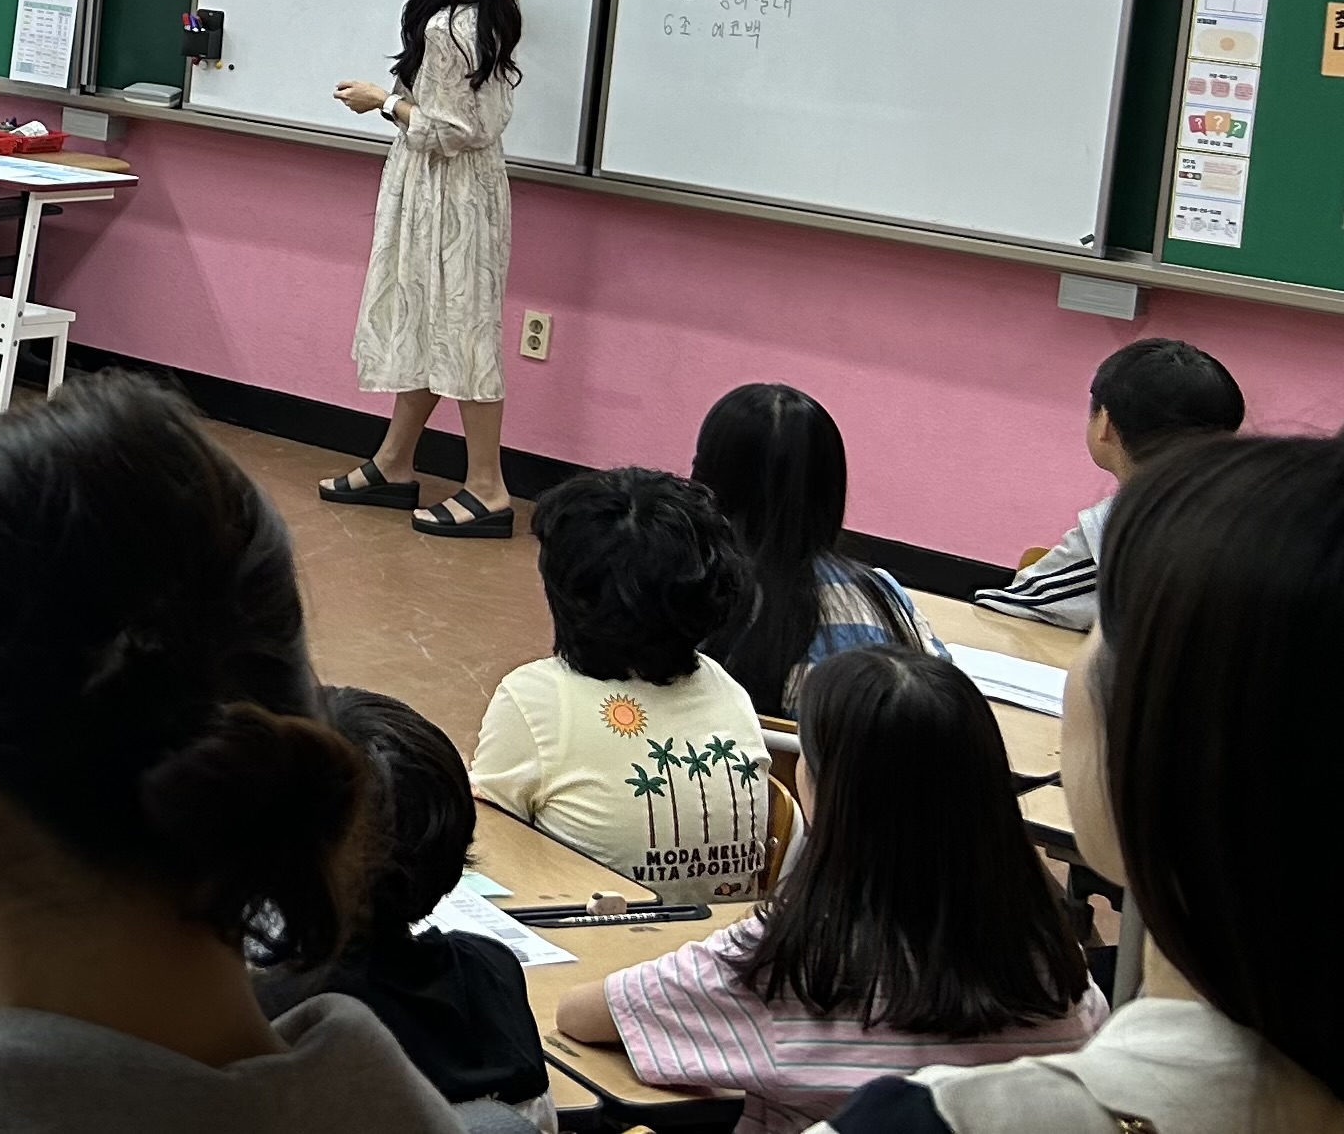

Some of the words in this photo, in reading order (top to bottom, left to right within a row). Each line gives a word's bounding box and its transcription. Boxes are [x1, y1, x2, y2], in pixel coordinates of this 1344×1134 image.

[712, 19, 761, 49] 에코백
[632, 866, 680, 881] VITA
[687, 852, 762, 878] SPORTIVA
[645, 848, 701, 866] MODA
[708, 840, 756, 861] NELLA
